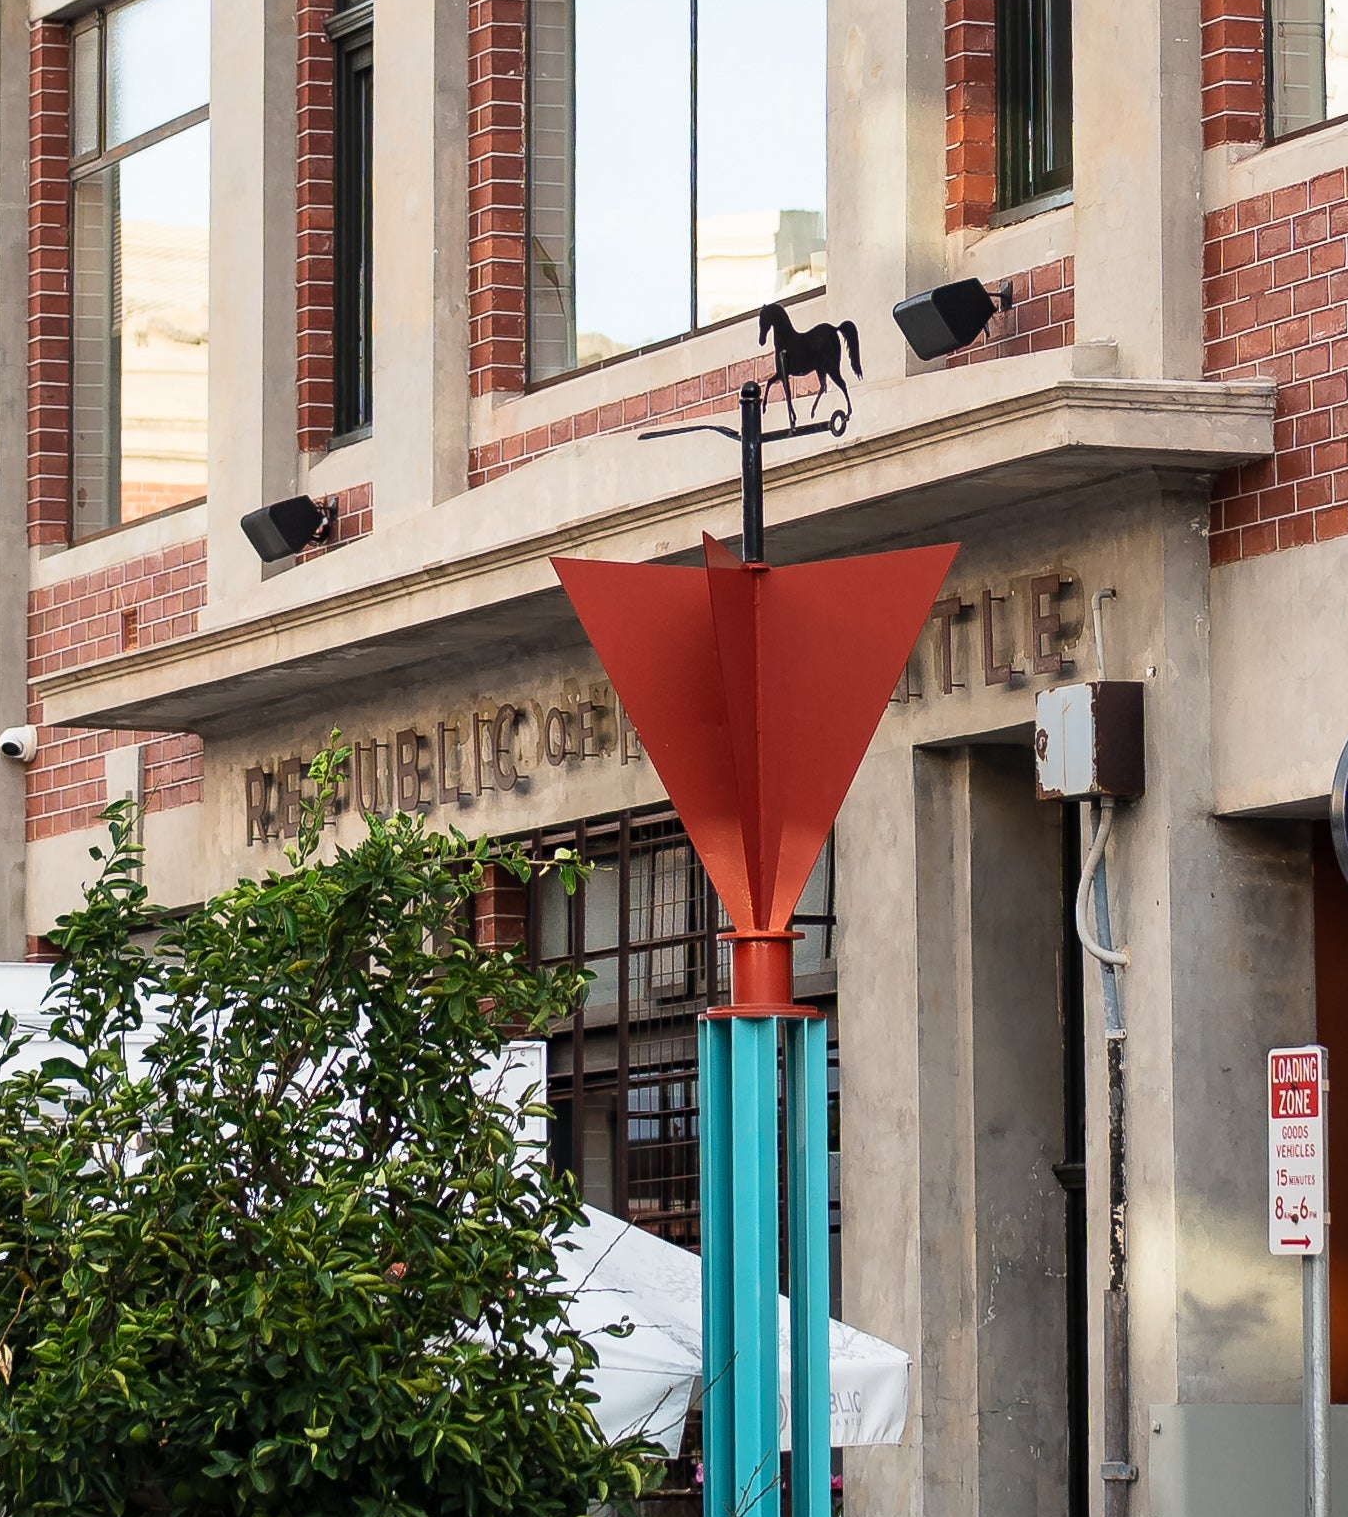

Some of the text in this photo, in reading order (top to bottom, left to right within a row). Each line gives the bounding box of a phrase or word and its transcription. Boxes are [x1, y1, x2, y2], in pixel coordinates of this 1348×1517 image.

[544, 699, 593, 766] OF
[1272, 1056, 1317, 1084] LOADING
[1278, 1088, 1312, 1115] ZONE
[1281, 1125, 1309, 1139] GOODS
[1276, 1143, 1316, 1158] VEHICLES
[1276, 1169, 1288, 1186] 15
